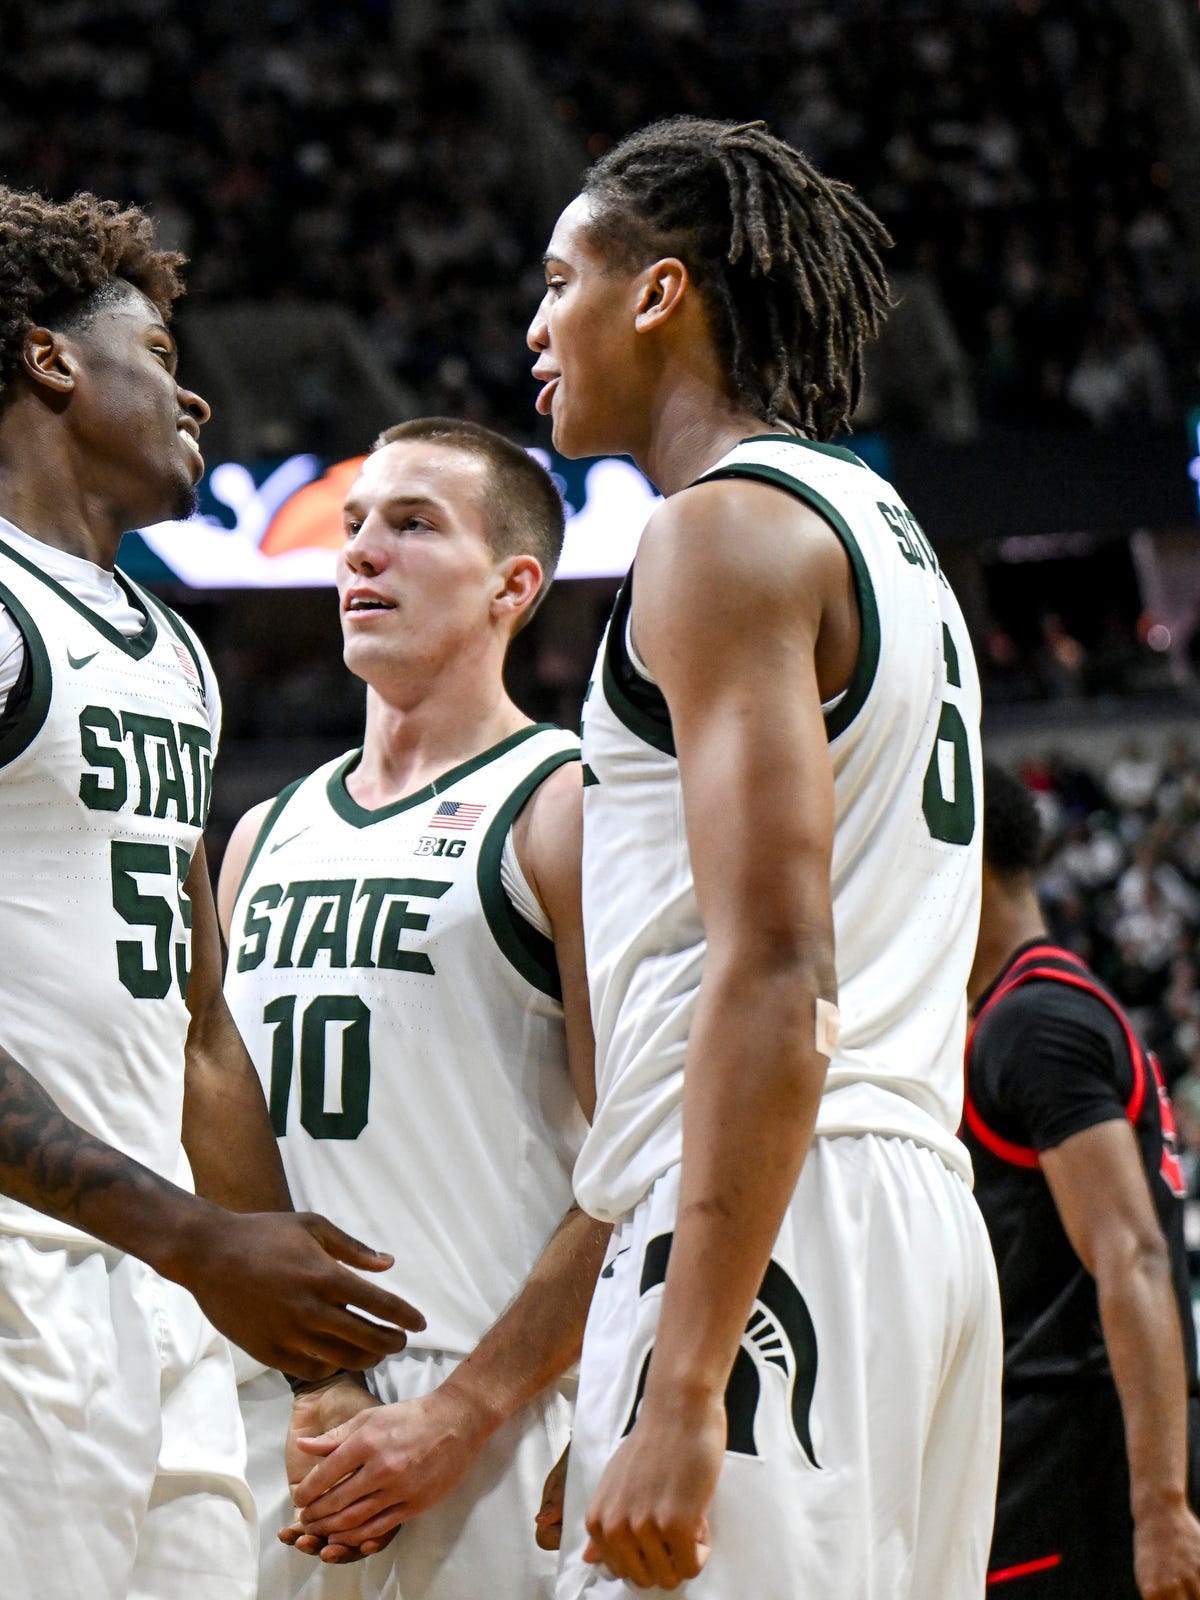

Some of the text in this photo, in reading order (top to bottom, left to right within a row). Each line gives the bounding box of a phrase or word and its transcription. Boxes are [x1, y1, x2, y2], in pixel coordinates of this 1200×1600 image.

[876, 501, 948, 589] SCO
[236, 878, 454, 976] STATE
[263, 994, 371, 1142] 10
